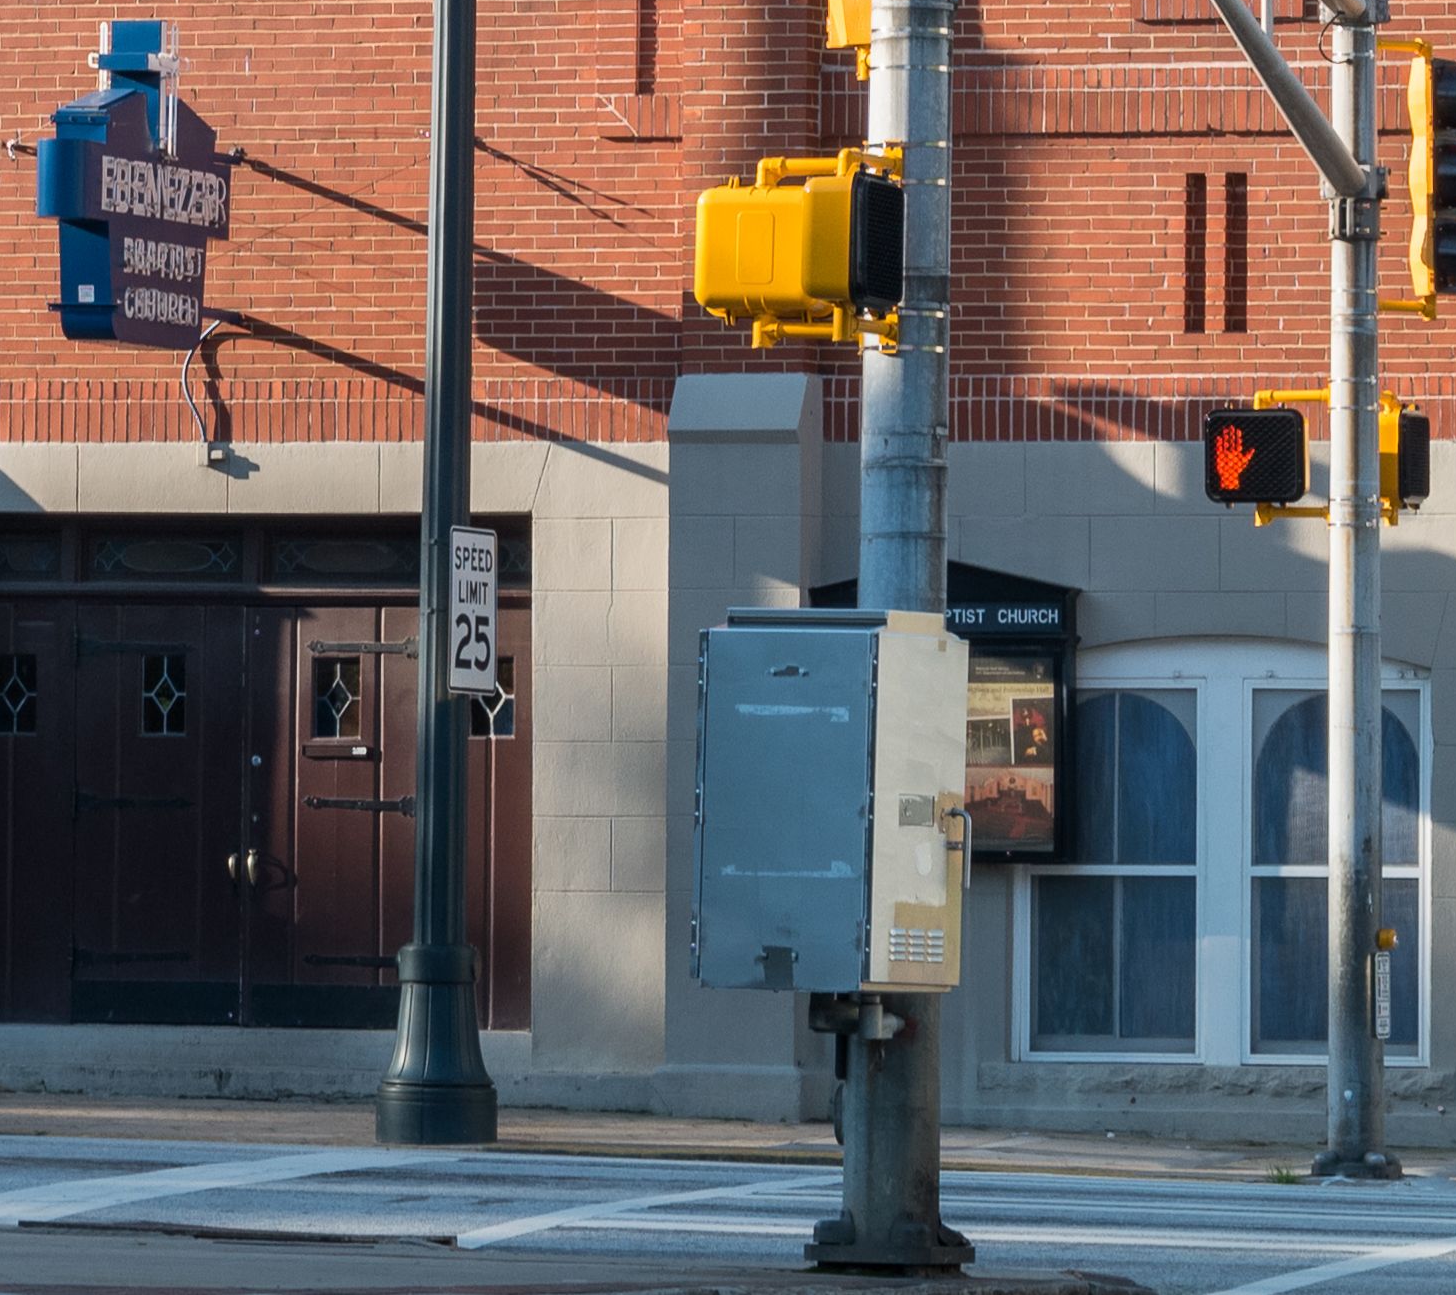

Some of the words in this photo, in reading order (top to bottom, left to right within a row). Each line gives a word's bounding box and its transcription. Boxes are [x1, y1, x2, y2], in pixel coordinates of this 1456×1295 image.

[101, 155, 227, 229] EBENEZER
[123, 237, 204, 282] BAPTIST
[124, 286, 199, 327] CHURCH
[454, 545, 493, 573] SPEED
[458, 580, 489, 606] LIMIT
[998, 608, 1059, 624] CHURCH
[454, 613, 491, 672] 25
